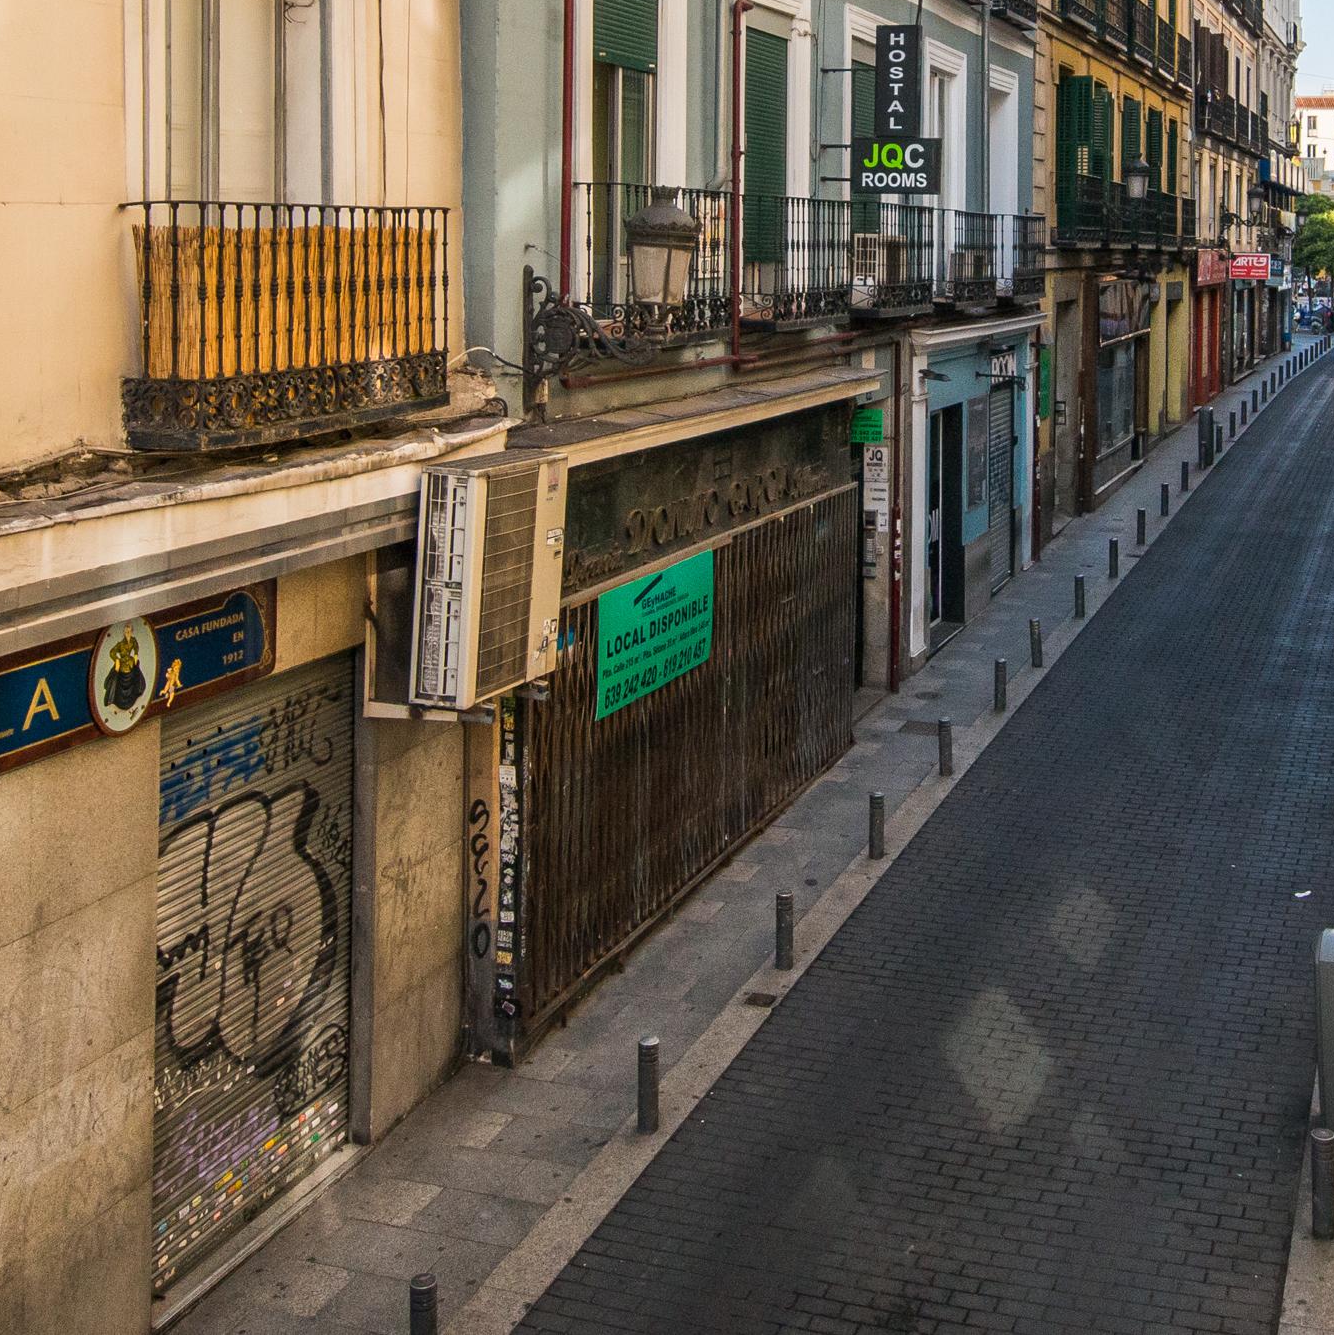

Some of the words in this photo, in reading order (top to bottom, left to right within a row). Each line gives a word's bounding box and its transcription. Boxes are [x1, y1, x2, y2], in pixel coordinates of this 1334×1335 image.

[886, 32, 906, 130] HOSTAL
[863, 143, 925, 170] JQC
[861, 172, 928, 188] ROOMS
[868, 449, 884, 462] JQ
[175, 626, 200, 641] CASA
[201, 612, 244, 634] FUNDADA
[232, 631, 244, 643] EN
[606, 625, 646, 659] LOCAL
[649, 594, 708, 640] DISPONIBLE
[222, 649, 244, 665] 1912
[604, 684, 621, 711] 639
[623, 673, 639, 699] 242
[640, 664, 657, 690] 420
[663, 655, 678, 680] 619
[693, 637, 707, 662] 457
